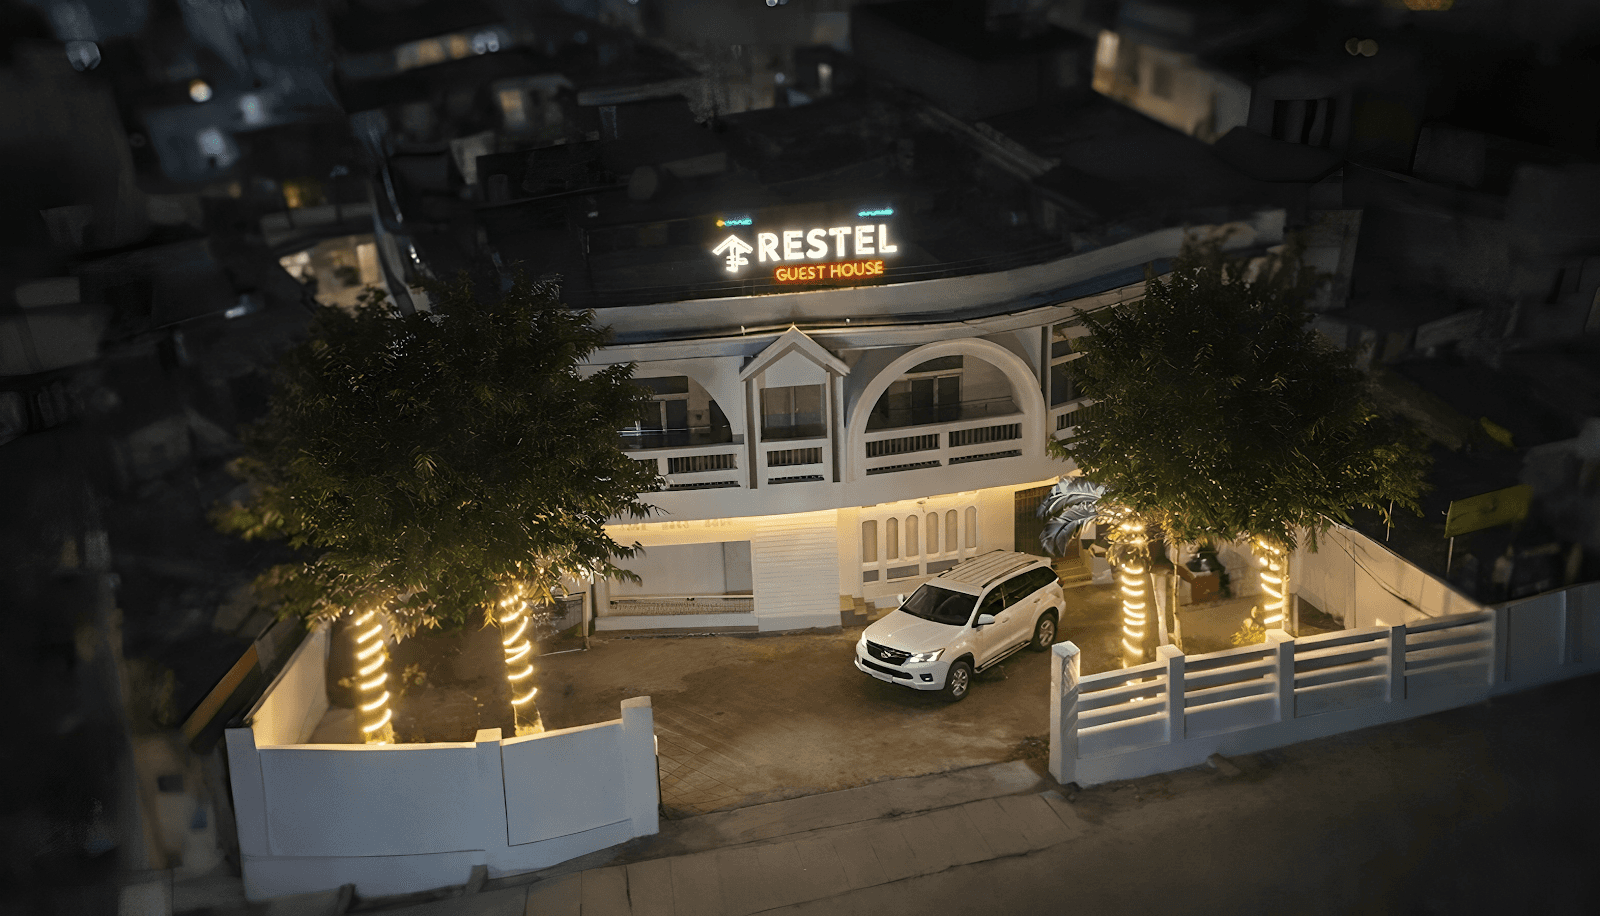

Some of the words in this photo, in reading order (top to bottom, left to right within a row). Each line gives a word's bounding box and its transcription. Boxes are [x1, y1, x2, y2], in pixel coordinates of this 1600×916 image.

[758, 225, 897, 262] RESTEL
[776, 266, 826, 281] GUEST
[830, 262, 884, 278] HOUSE
